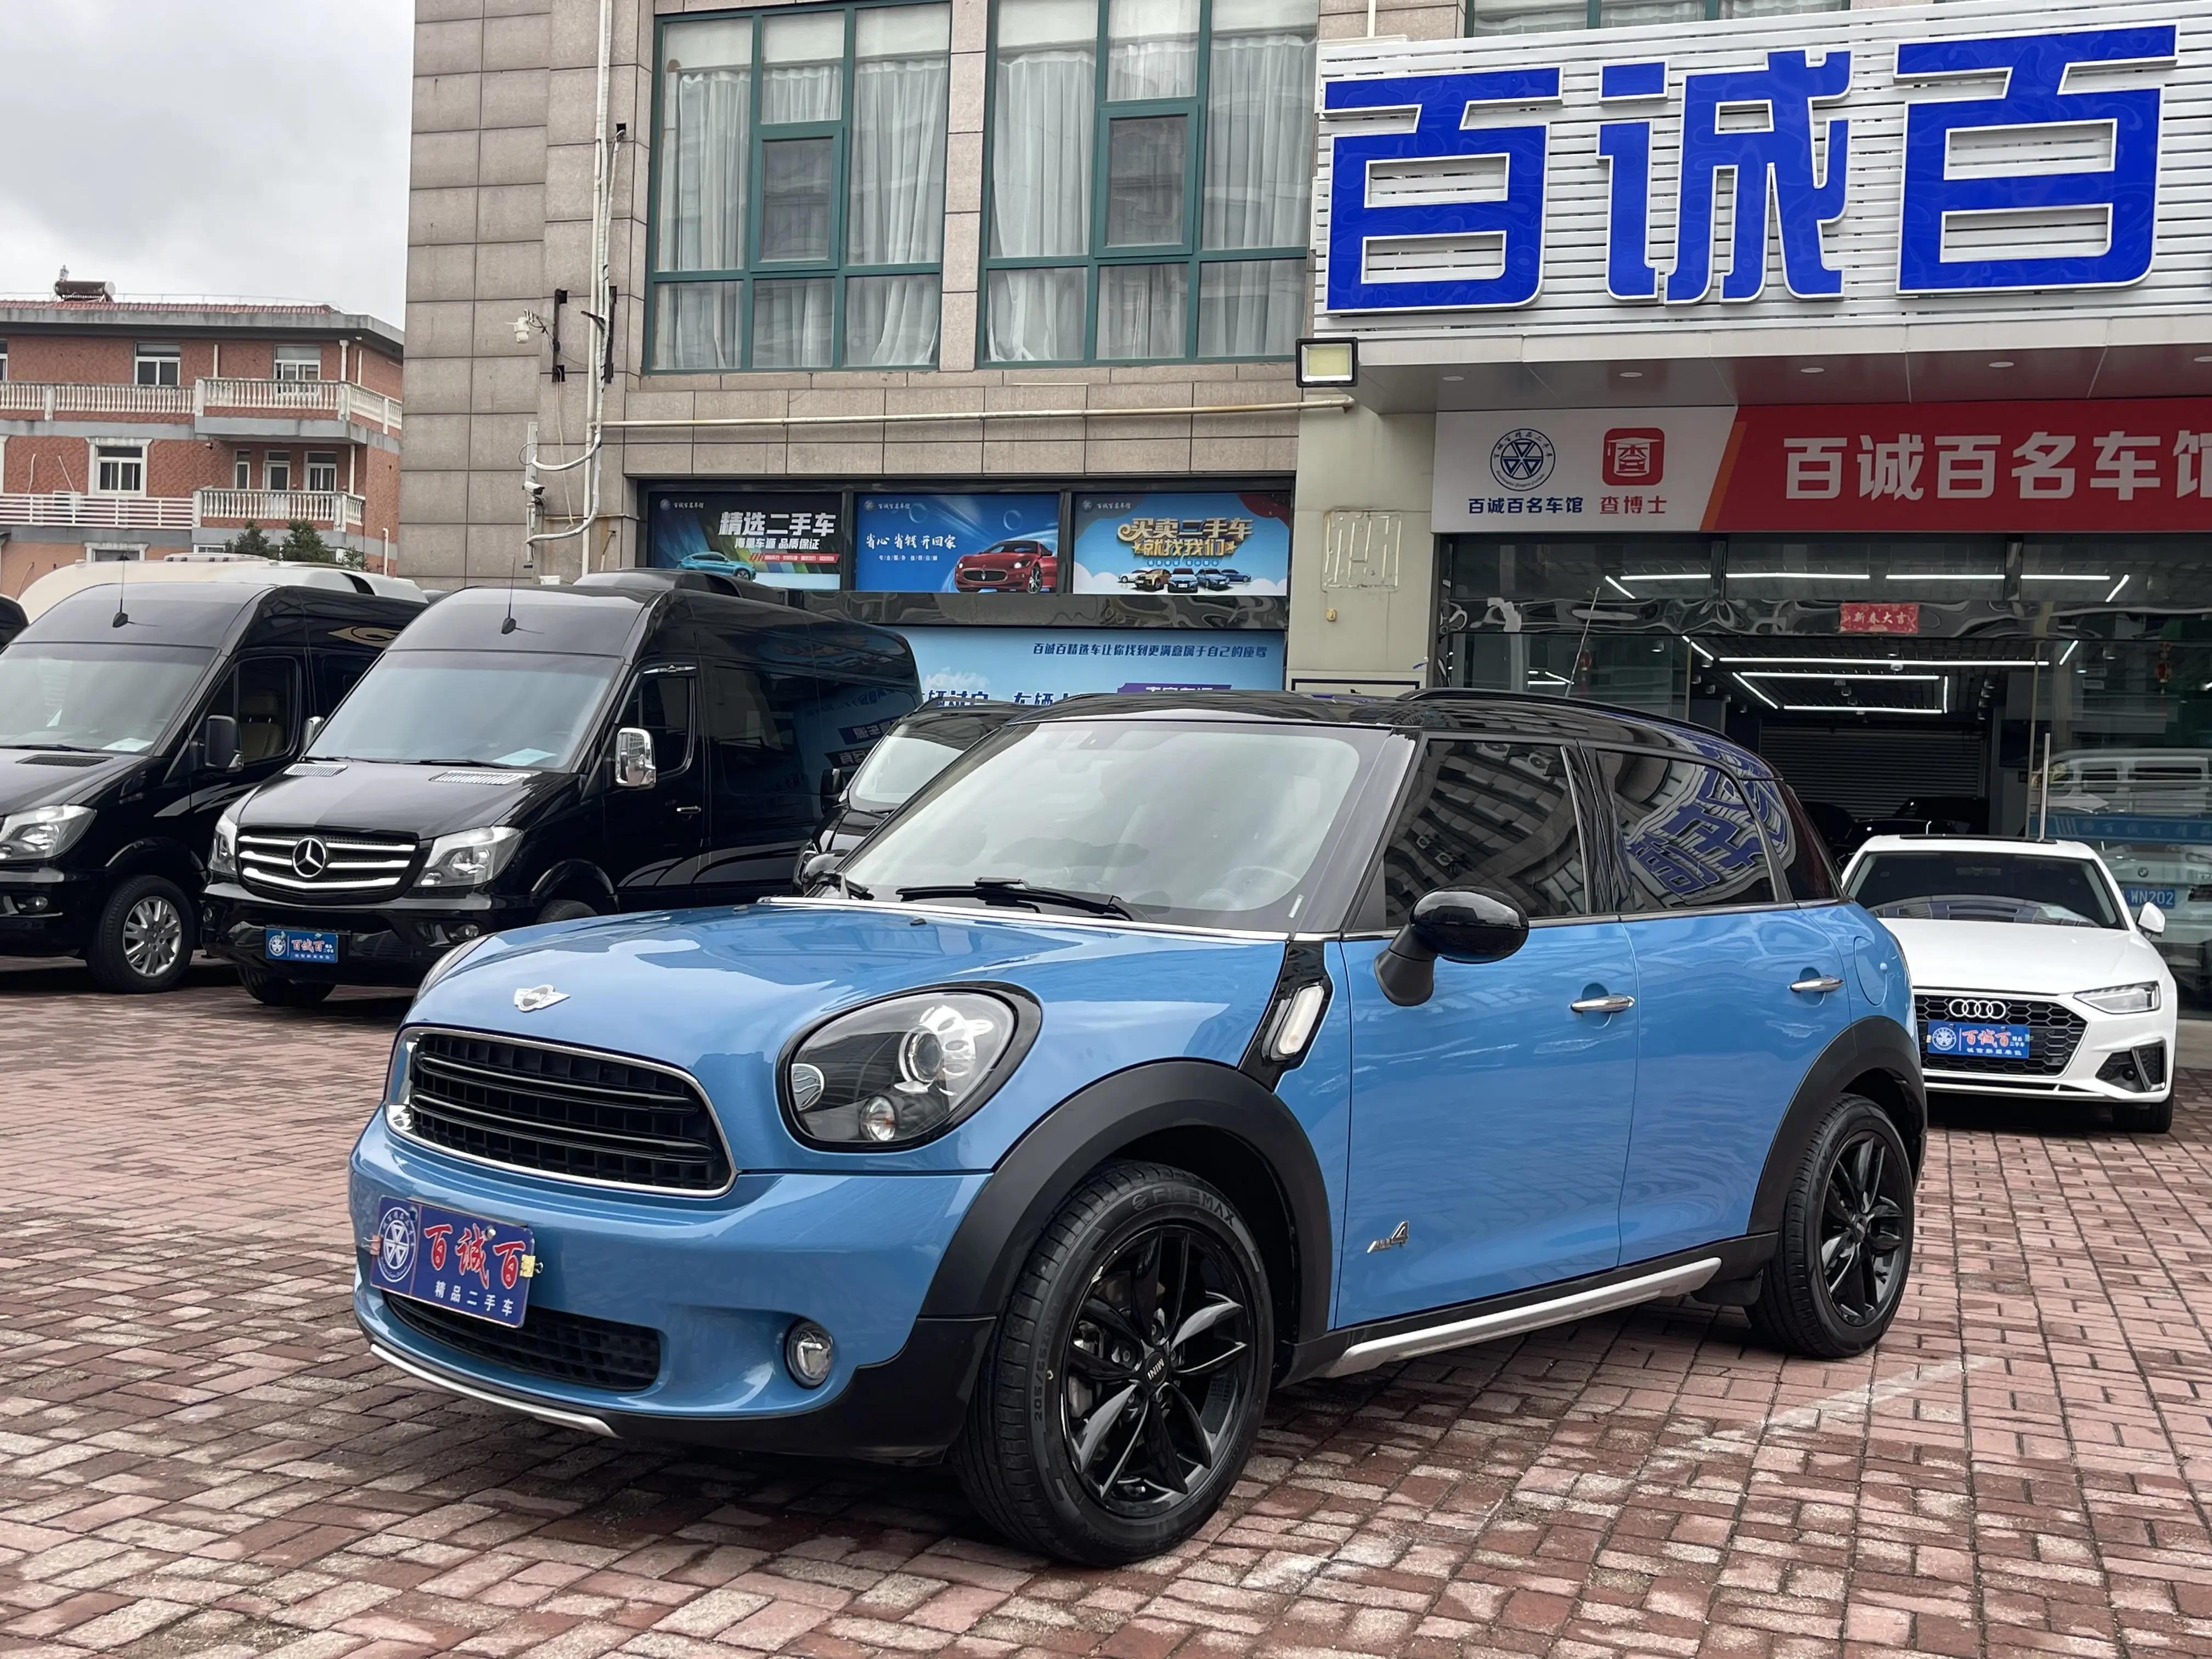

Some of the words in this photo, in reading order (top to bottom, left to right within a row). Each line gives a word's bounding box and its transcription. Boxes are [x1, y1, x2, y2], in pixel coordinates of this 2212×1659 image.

[1320, 20, 2180, 315] 百诚百
[1468, 496, 1583, 514] 百诚百名车馆
[1600, 495, 1667, 515] 查博士
[718, 511, 837, 537] 精选二手车
[1117, 517, 1254, 541] 买卖二手车
[778, 538, 821, 550] 品质保证
[866, 533, 890, 550] 省心
[894, 533, 917, 550] 省钱
[921, 534, 957, 550] 开回家
[1143, 538, 1225, 556] 就找我们
[424, 1222, 526, 1290] 百诚百
[434, 1279, 515, 1317] 精品二手车
[1147, 1358, 1165, 1380] MINI
